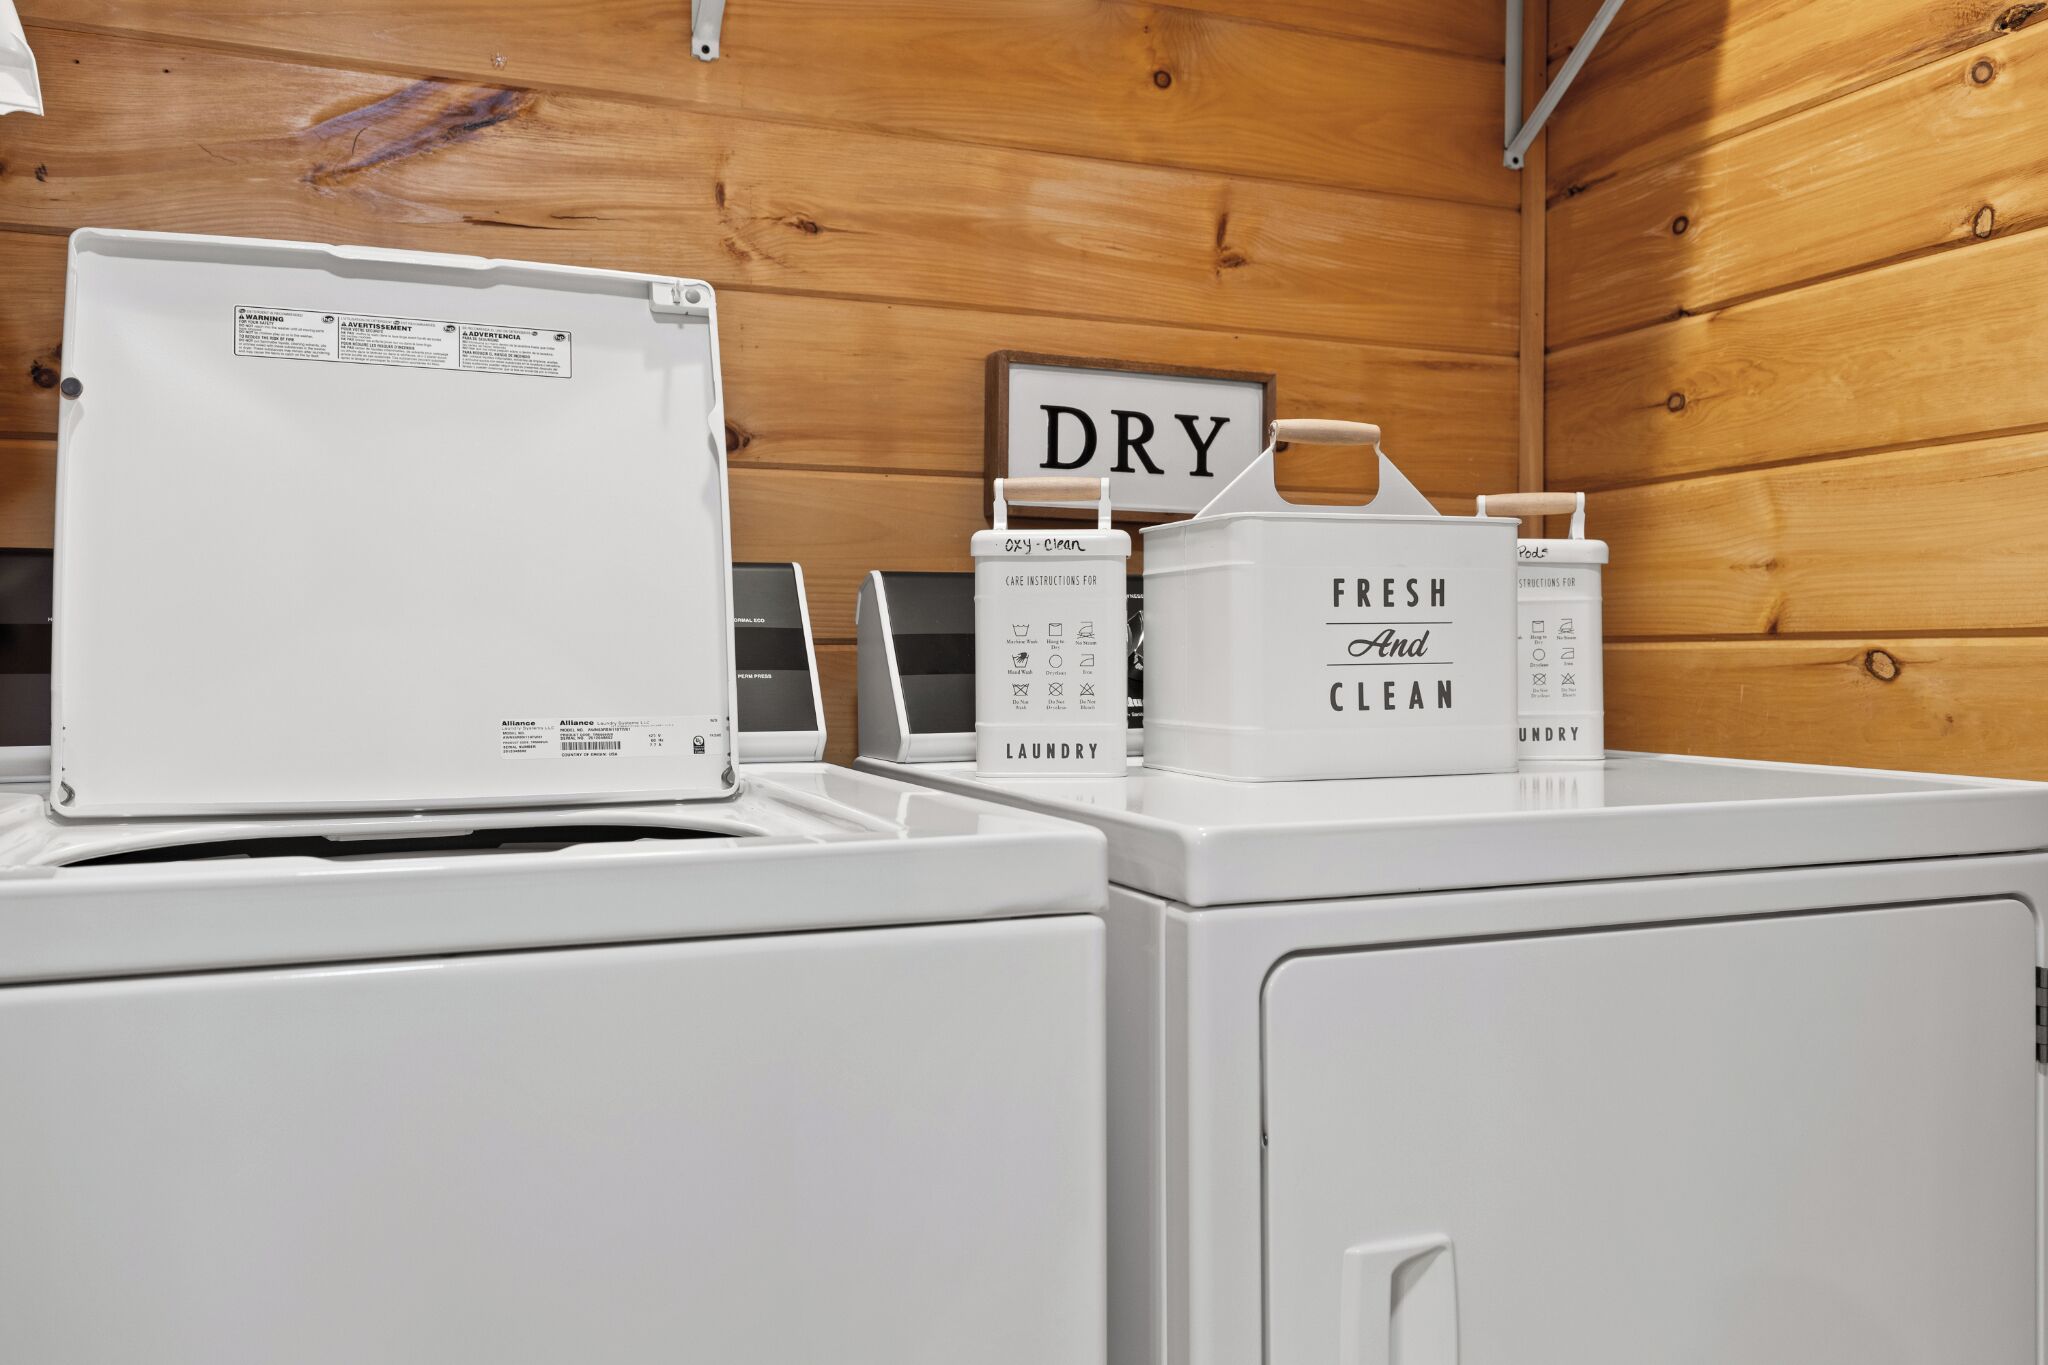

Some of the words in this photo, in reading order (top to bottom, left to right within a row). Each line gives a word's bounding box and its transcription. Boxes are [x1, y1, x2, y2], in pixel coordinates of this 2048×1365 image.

[348, 322, 412, 331] AVERTISSEMENT
[469, 332, 520, 340] ADVERTENCIA
[1040, 404, 1230, 477] DRY
[1006, 576, 1024, 586] CARE
[1027, 576, 1080, 586] INSTRUCTIONS
[1083, 575, 1097, 585] FOR
[1519, 578, 1560, 588] STRUCTIONS
[1562, 577, 1576, 586] FOR
[1334, 578, 1445, 607] FRESH
[1348, 629, 1430, 657] And
[1330, 680, 1452, 712] CLEAN
[1519, 727, 1579, 742] UNDRY
[1007, 743, 1097, 759] LAUNDRY
